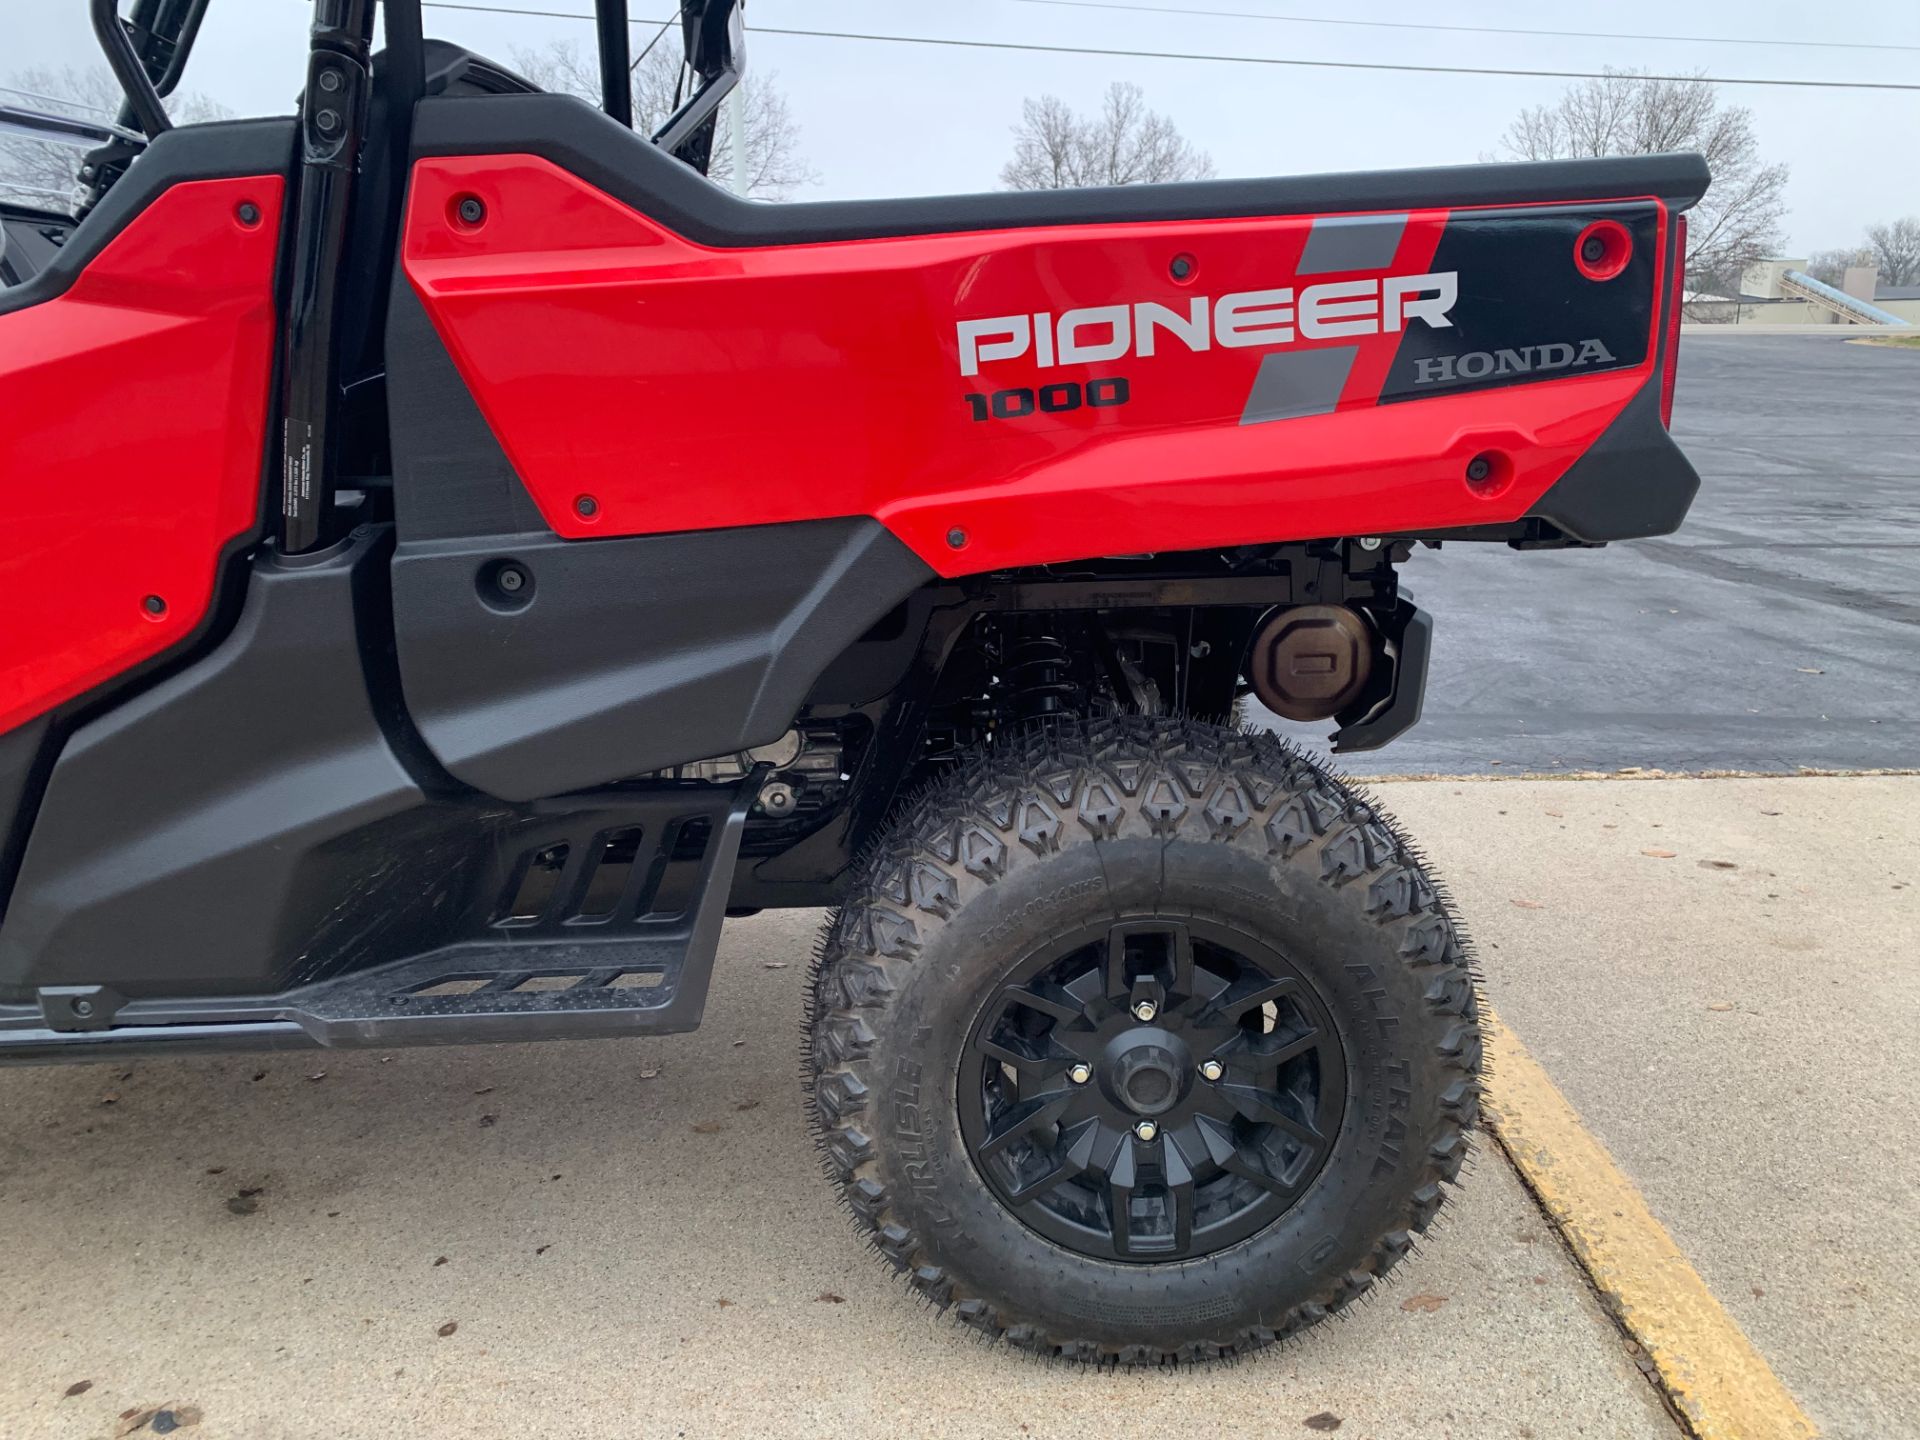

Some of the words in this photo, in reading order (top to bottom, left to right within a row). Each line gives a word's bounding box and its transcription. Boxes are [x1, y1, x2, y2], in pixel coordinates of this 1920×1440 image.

[956, 271, 1458, 377] PIONEER
[1414, 338, 1616, 384] HONDA
[965, 376, 1130, 422] 1000
[1344, 963, 1400, 1041] ALL
[1369, 1058, 1411, 1186] TRAIL
